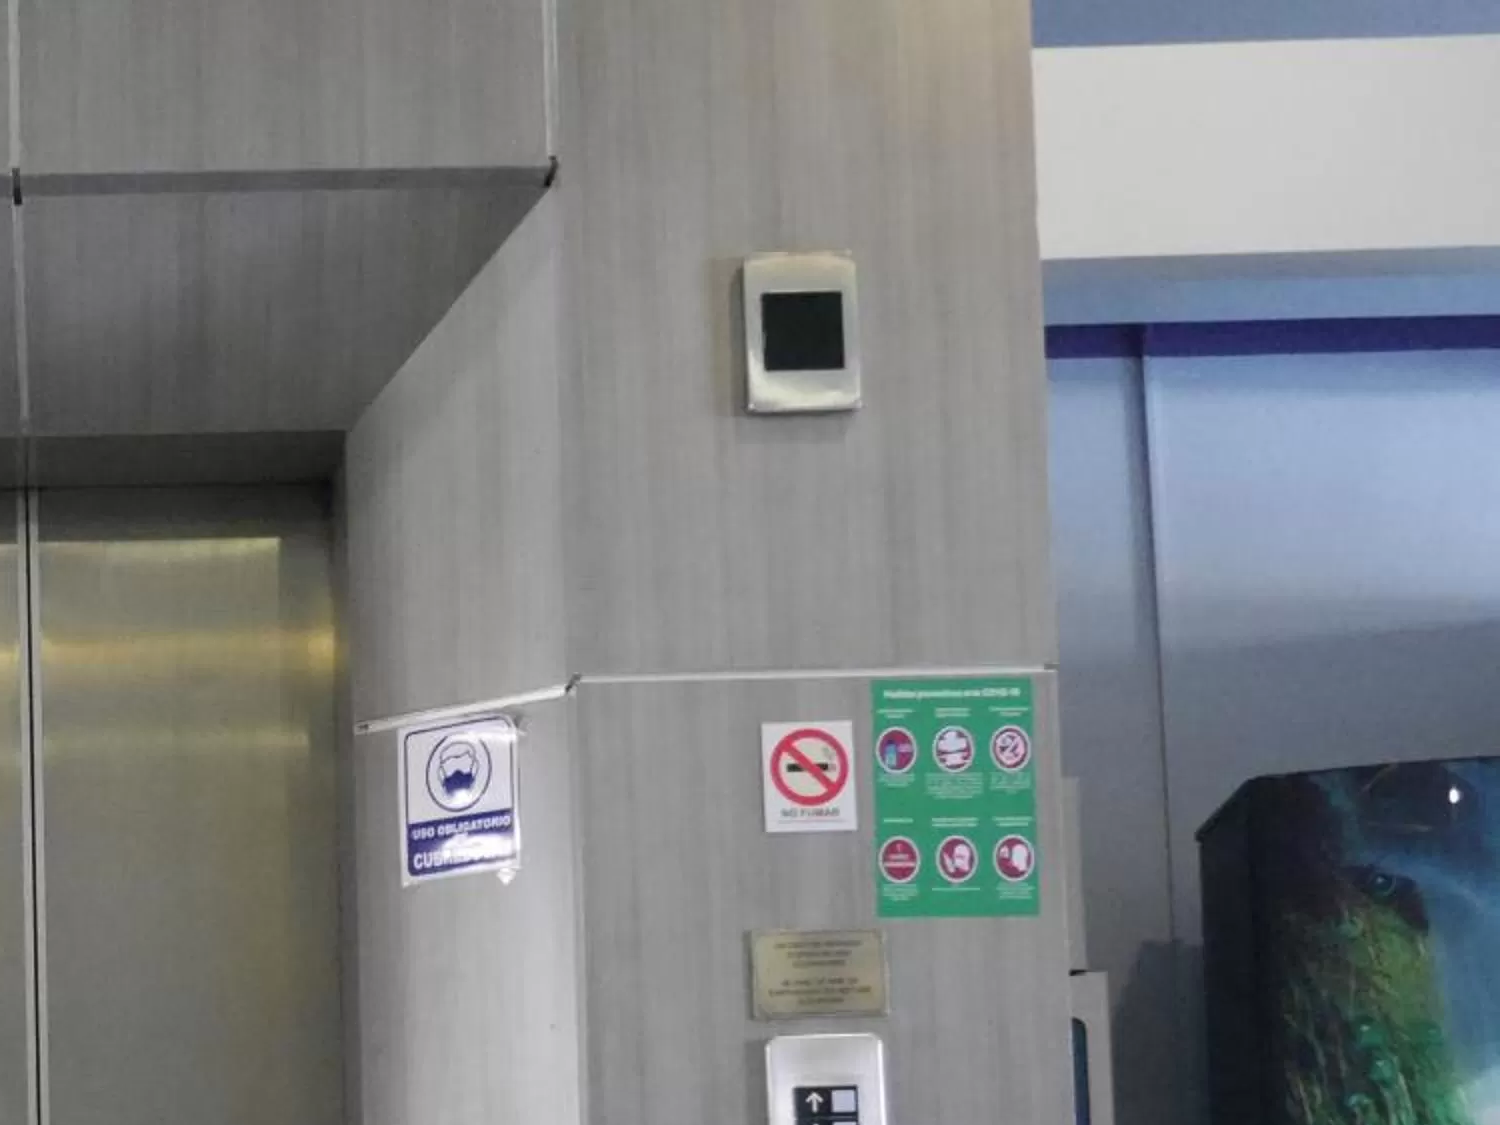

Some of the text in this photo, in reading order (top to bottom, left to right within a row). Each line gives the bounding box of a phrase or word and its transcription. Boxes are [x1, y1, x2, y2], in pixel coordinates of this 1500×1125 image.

[781, 807, 840, 817] NO FUMAR
[412, 815, 511, 840] USO OBLIGATORIO
